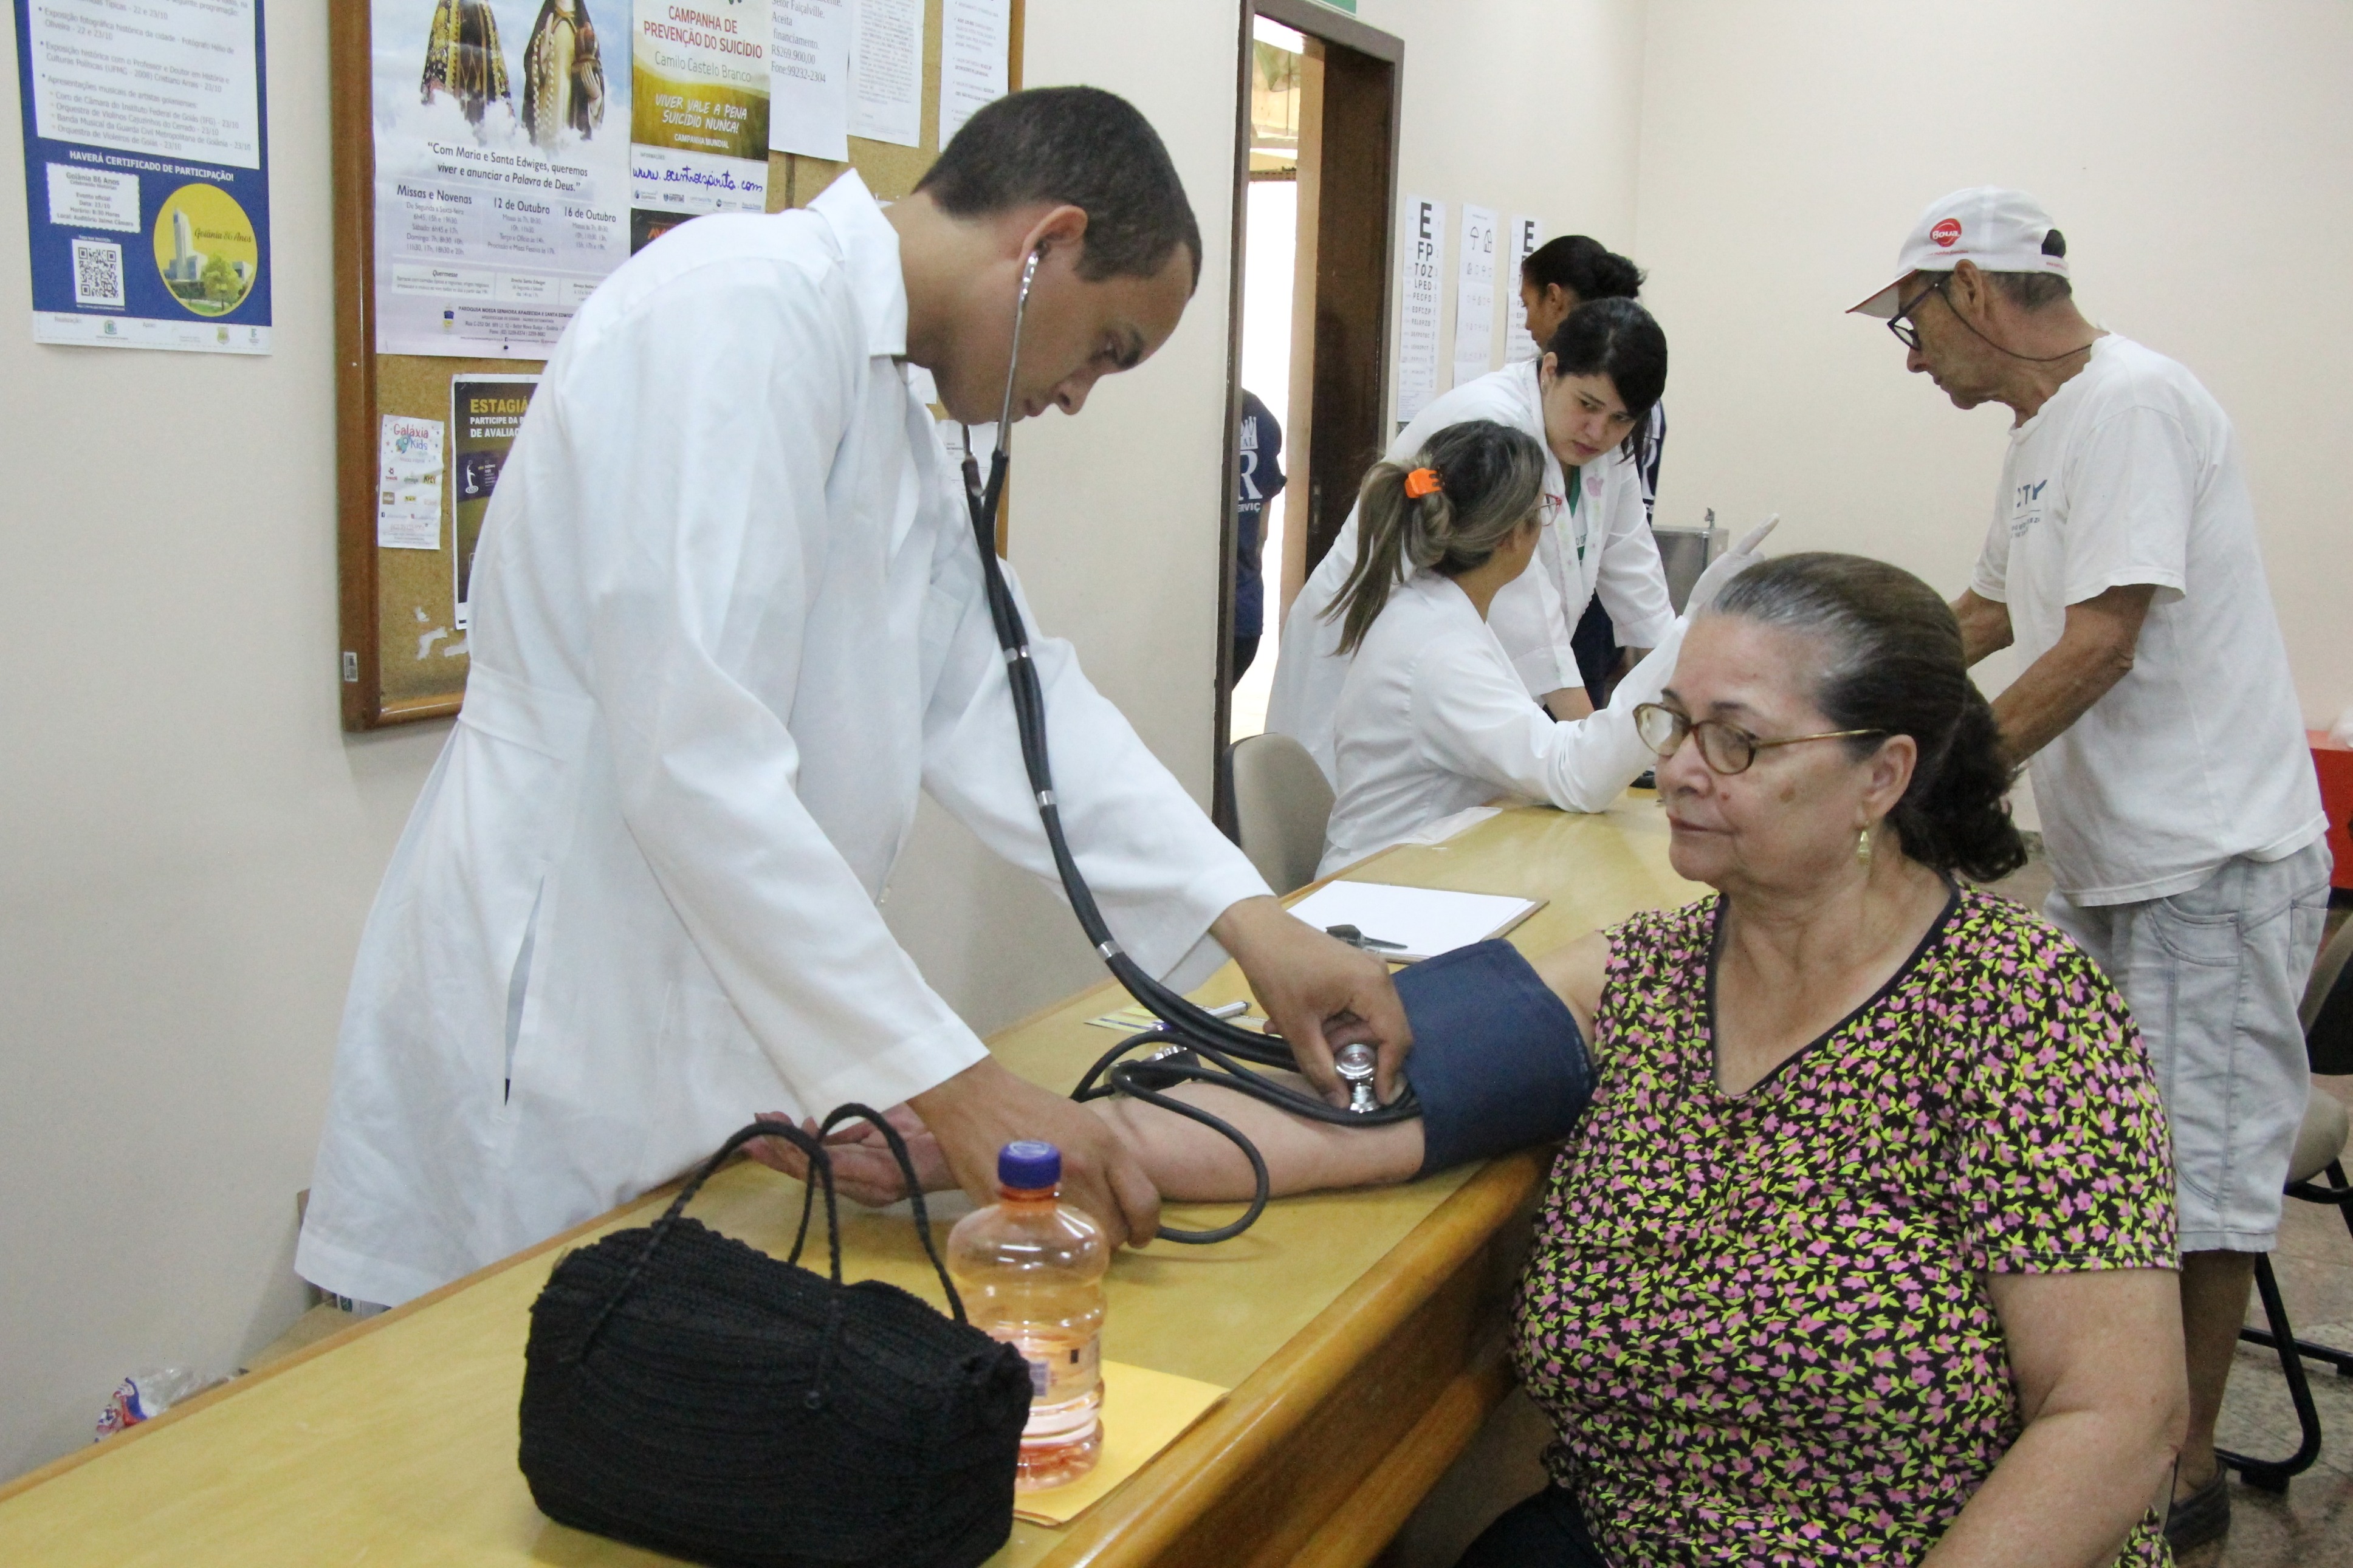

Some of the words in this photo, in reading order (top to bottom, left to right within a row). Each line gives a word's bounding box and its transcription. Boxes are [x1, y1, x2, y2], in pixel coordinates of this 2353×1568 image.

[669, 5, 721, 31] CAMPANHA
[724, 19, 737, 34] DE
[772, 11, 792, 26] Aceita
[644, 21, 702, 47] PREVENÇÃO
[705, 34, 716, 49] DO
[720, 38, 762, 59] SUICÍDIO
[774, 28, 820, 50] financiamento.
[771, 44, 816, 64] R$269.900,00
[655, 51, 685, 69] Camilo
[688, 58, 720, 77] Castelo
[722, 64, 751, 83] Branco
[771, 61, 826, 83] Fone:99232-2304
[656, 94, 683, 109] VIVER
[688, 99, 710, 114] VALE
[713, 104, 721, 115] A
[724, 104, 747, 120] PENA
[662, 109, 702, 128] SUICÍDIO
[706, 117, 740, 134] NUNCA!
[675, 134, 705, 145] CAMPANHA
[706, 139, 729, 149] MUNDIAL
[70, 150, 104, 163] HAVERÁ
[106, 156, 160, 171] CERTIFICADO
[162, 163, 173, 173] DE
[175, 166, 234, 182] PARTICIPAÇÃO!
[456, 146, 481, 160] Maria
[484, 153, 489, 162] e
[491, 152, 514, 166] Santa
[517, 156, 549, 173] Edwiges,
[551, 164, 588, 177] queremos
[66, 172, 91, 182] Goiânia
[103, 177, 120, 186] Anos
[438, 162, 457, 174] viver
[467, 169, 503, 181] anunciar
[512, 173, 541, 187] Palavra
[543, 177, 552, 188] de
[397, 184, 427, 199] Missas
[429, 191, 434, 199] e
[437, 189, 472, 204] Novenas
[493, 197, 502, 208] 12
[505, 199, 515, 210] de
[517, 200, 550, 214] Outubro
[565, 207, 572, 217] 16
[575, 209, 584, 219] de
[586, 209, 617, 222] Outubro
[1420, 202, 1432, 239] E
[1523, 221, 1534, 253] E
[433, 270, 458, 278] Quermesse
[394, 423, 428, 439] Galáxia
[470, 428, 482, 437] DE
[411, 439, 428, 450] Kids
